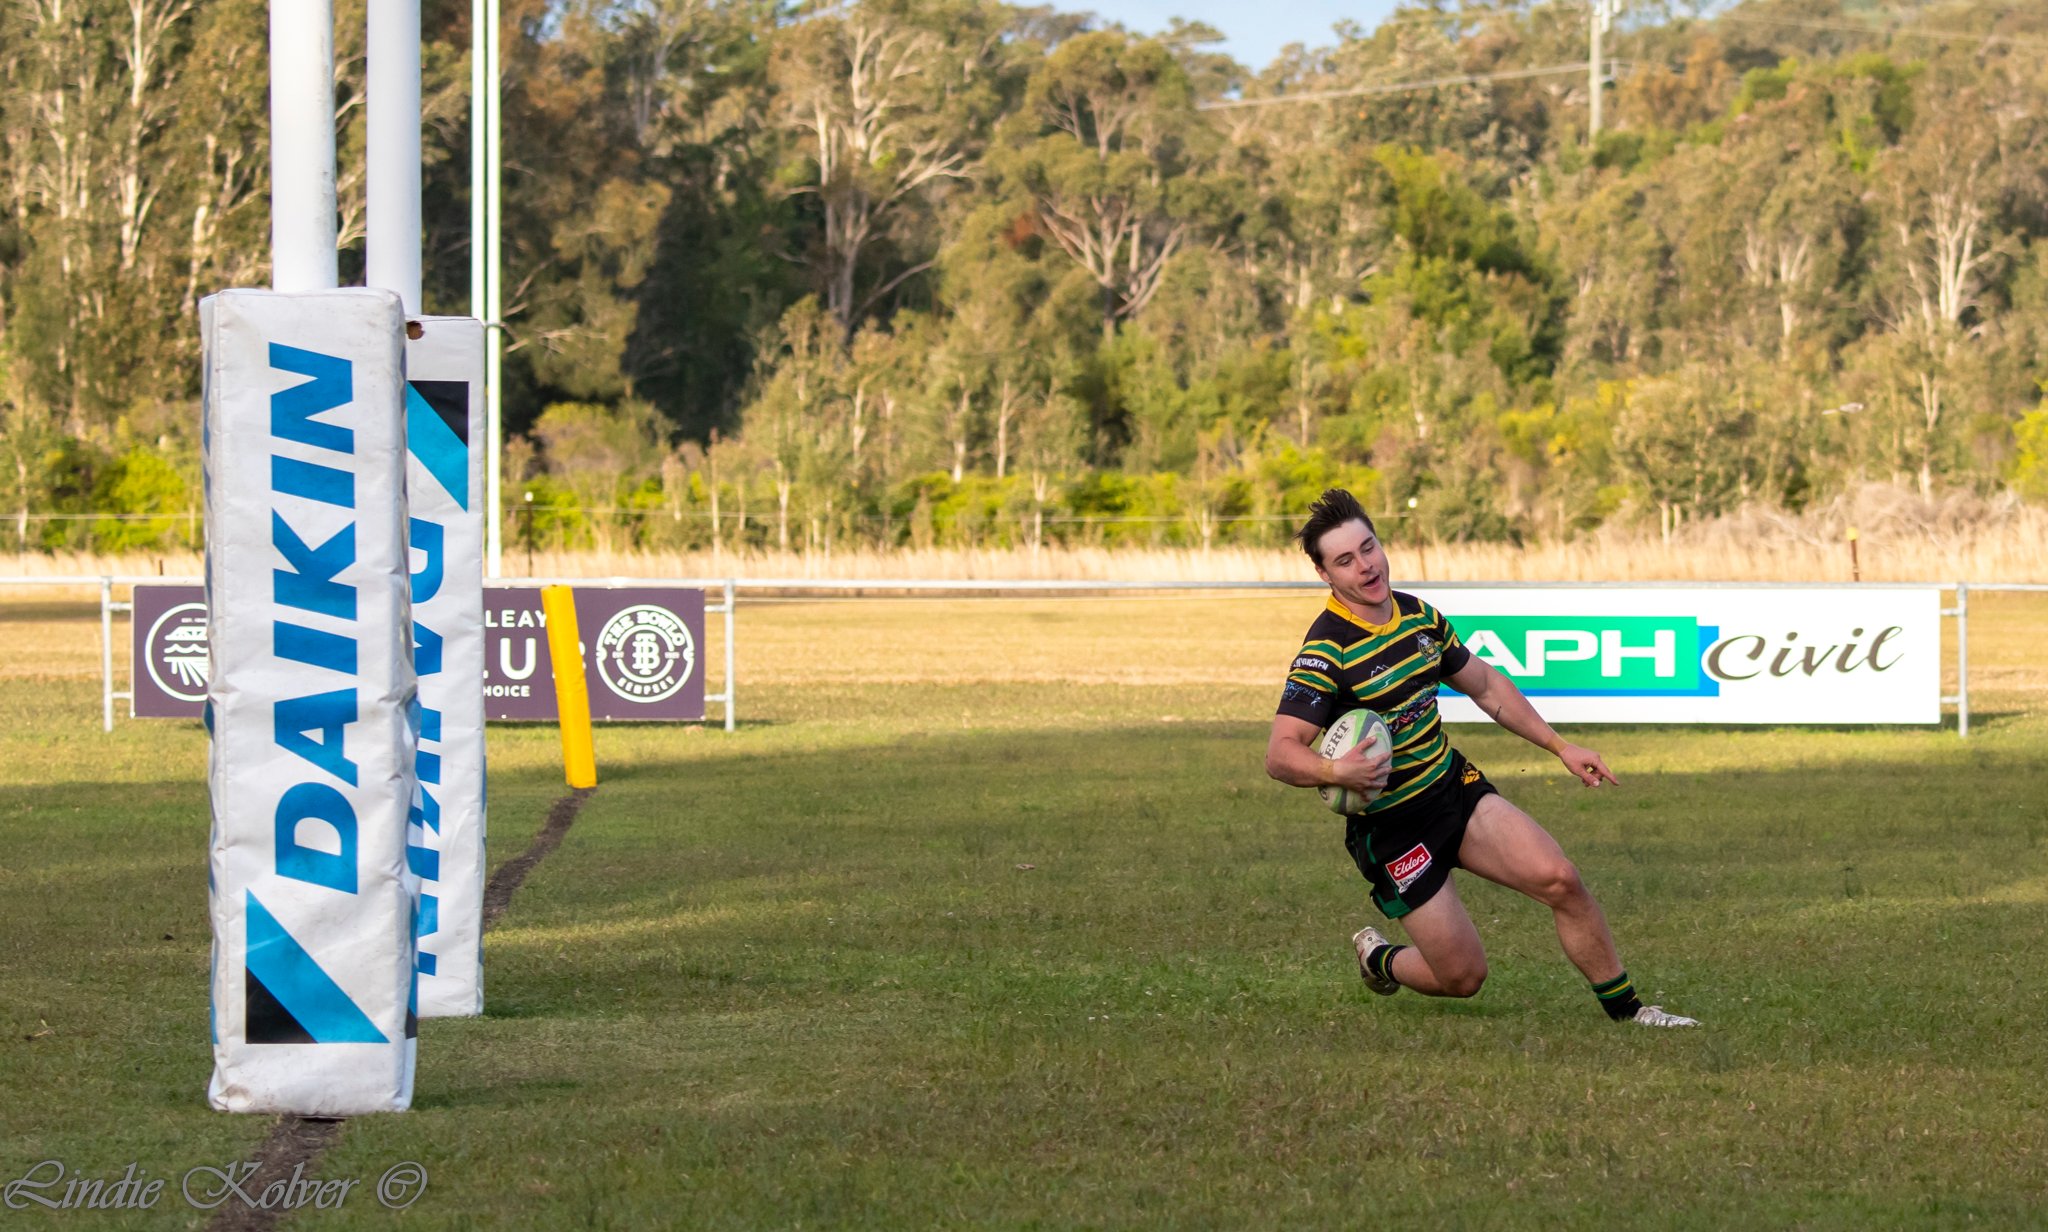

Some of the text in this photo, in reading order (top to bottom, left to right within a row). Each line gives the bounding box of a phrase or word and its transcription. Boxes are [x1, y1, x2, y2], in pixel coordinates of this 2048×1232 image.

[269, 341, 358, 895] DAIKIN
[484, 609, 547, 628] LEAY
[603, 610, 686, 647] THE BOWLO
[1463, 625, 1905, 681] APH Civil
[483, 684, 531, 698] HOICE
[1393, 852, 1426, 878] Elders
